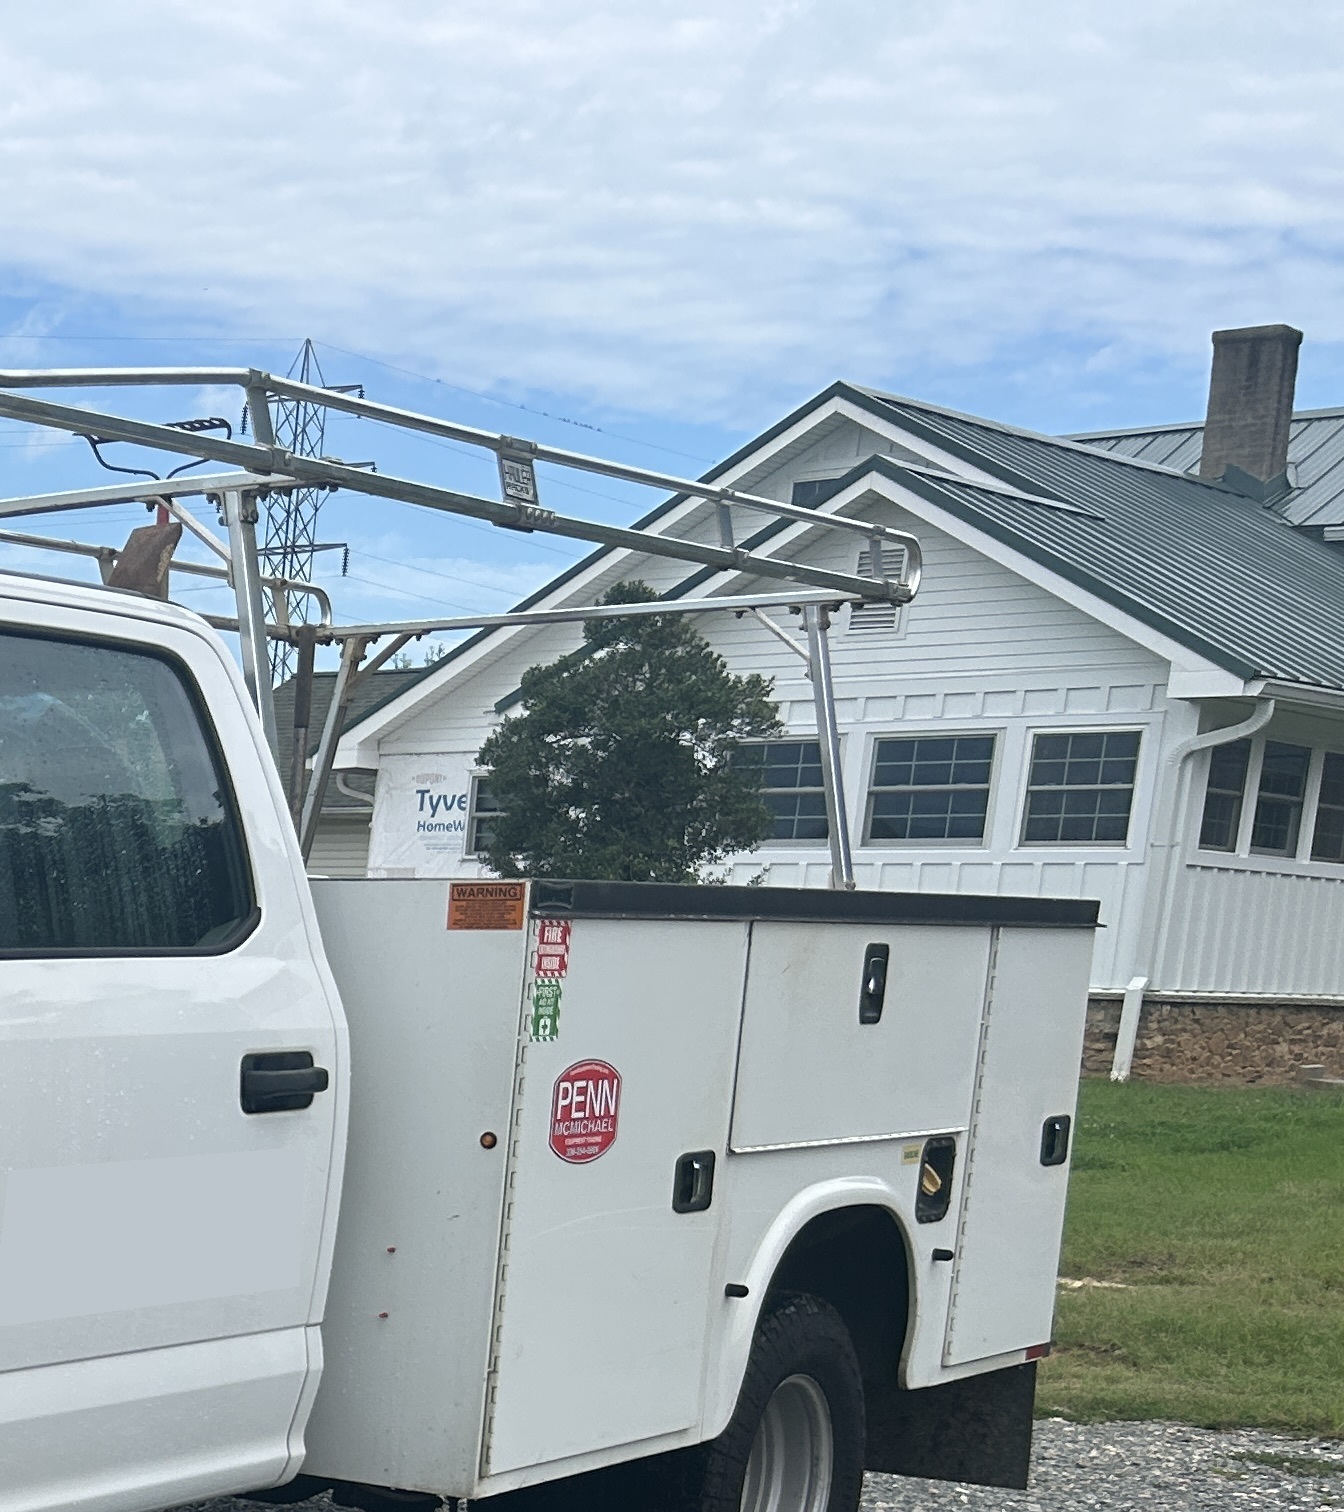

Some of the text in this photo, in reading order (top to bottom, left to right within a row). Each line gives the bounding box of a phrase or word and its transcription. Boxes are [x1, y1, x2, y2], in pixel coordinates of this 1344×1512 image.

[455, 886, 518, 898] WARNING
[543, 926, 563, 943] FIRE
[556, 1079, 618, 1120] PENN
[554, 1119, 614, 1136] MCMICHAEL
